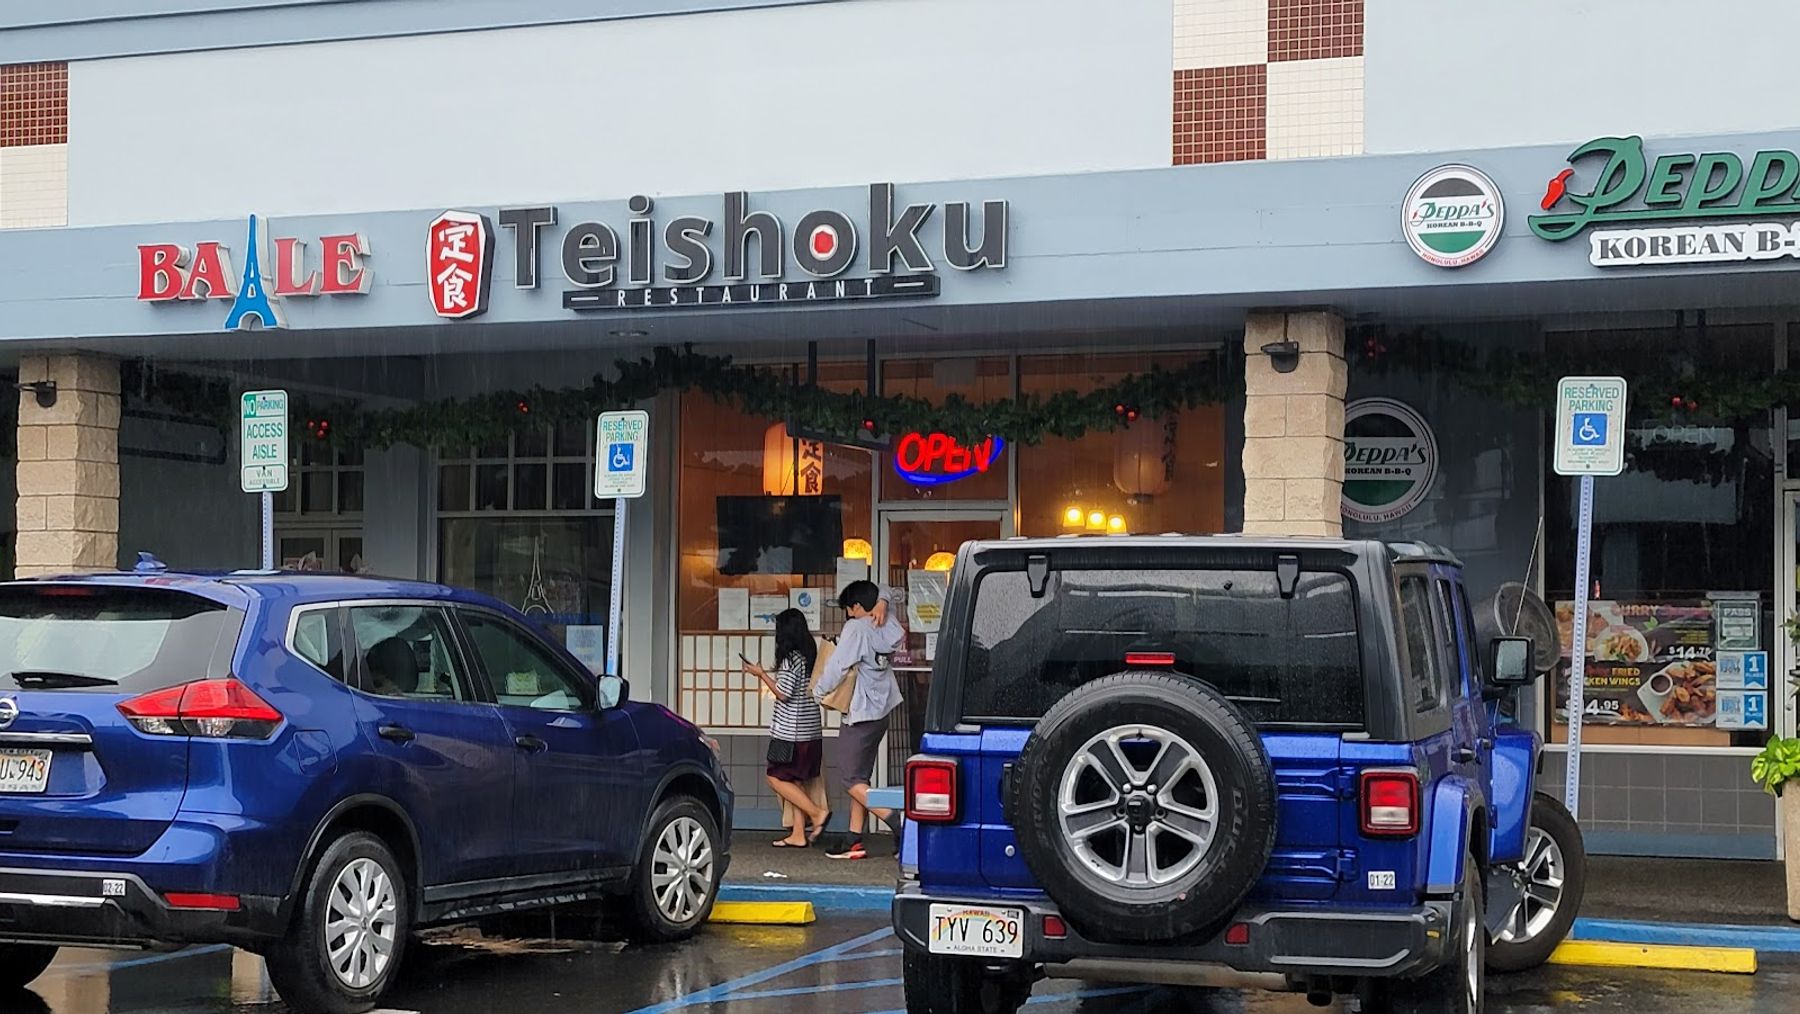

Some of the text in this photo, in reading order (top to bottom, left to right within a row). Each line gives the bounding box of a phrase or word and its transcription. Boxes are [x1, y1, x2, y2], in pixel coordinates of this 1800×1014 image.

[1530, 135, 1800, 240] PEPP
[1412, 199, 1495, 225] PEPPA'S
[1427, 220, 1482, 229] KOREAN B-B-Q
[498, 183, 1010, 289] Teishoku
[1598, 229, 1800, 260] KOREAN B-
[436, 221, 475, 310] 定食
[617, 279, 874, 307] RESTAURANT
[1564, 386, 1619, 399] RESERVED
[244, 399, 284, 416] NO PARKING
[1568, 399, 1614, 411] PARKING
[246, 422, 283, 439] ACCESS
[603, 420, 643, 432] RESERVED
[606, 431, 639, 442] PARKING
[252, 443, 278, 460] AISLE
[898, 432, 992, 473] OPEN
[256, 469, 273, 478] VAN
[1724, 608, 1752, 617] PASS
[1611, 667, 1641, 676] FRIED
[1609, 676, 1641, 686] WINGS
[17, 759, 46, 781] 943
[963, 909, 990, 917] HAWAII
[935, 916, 1018, 944] TYV 639
